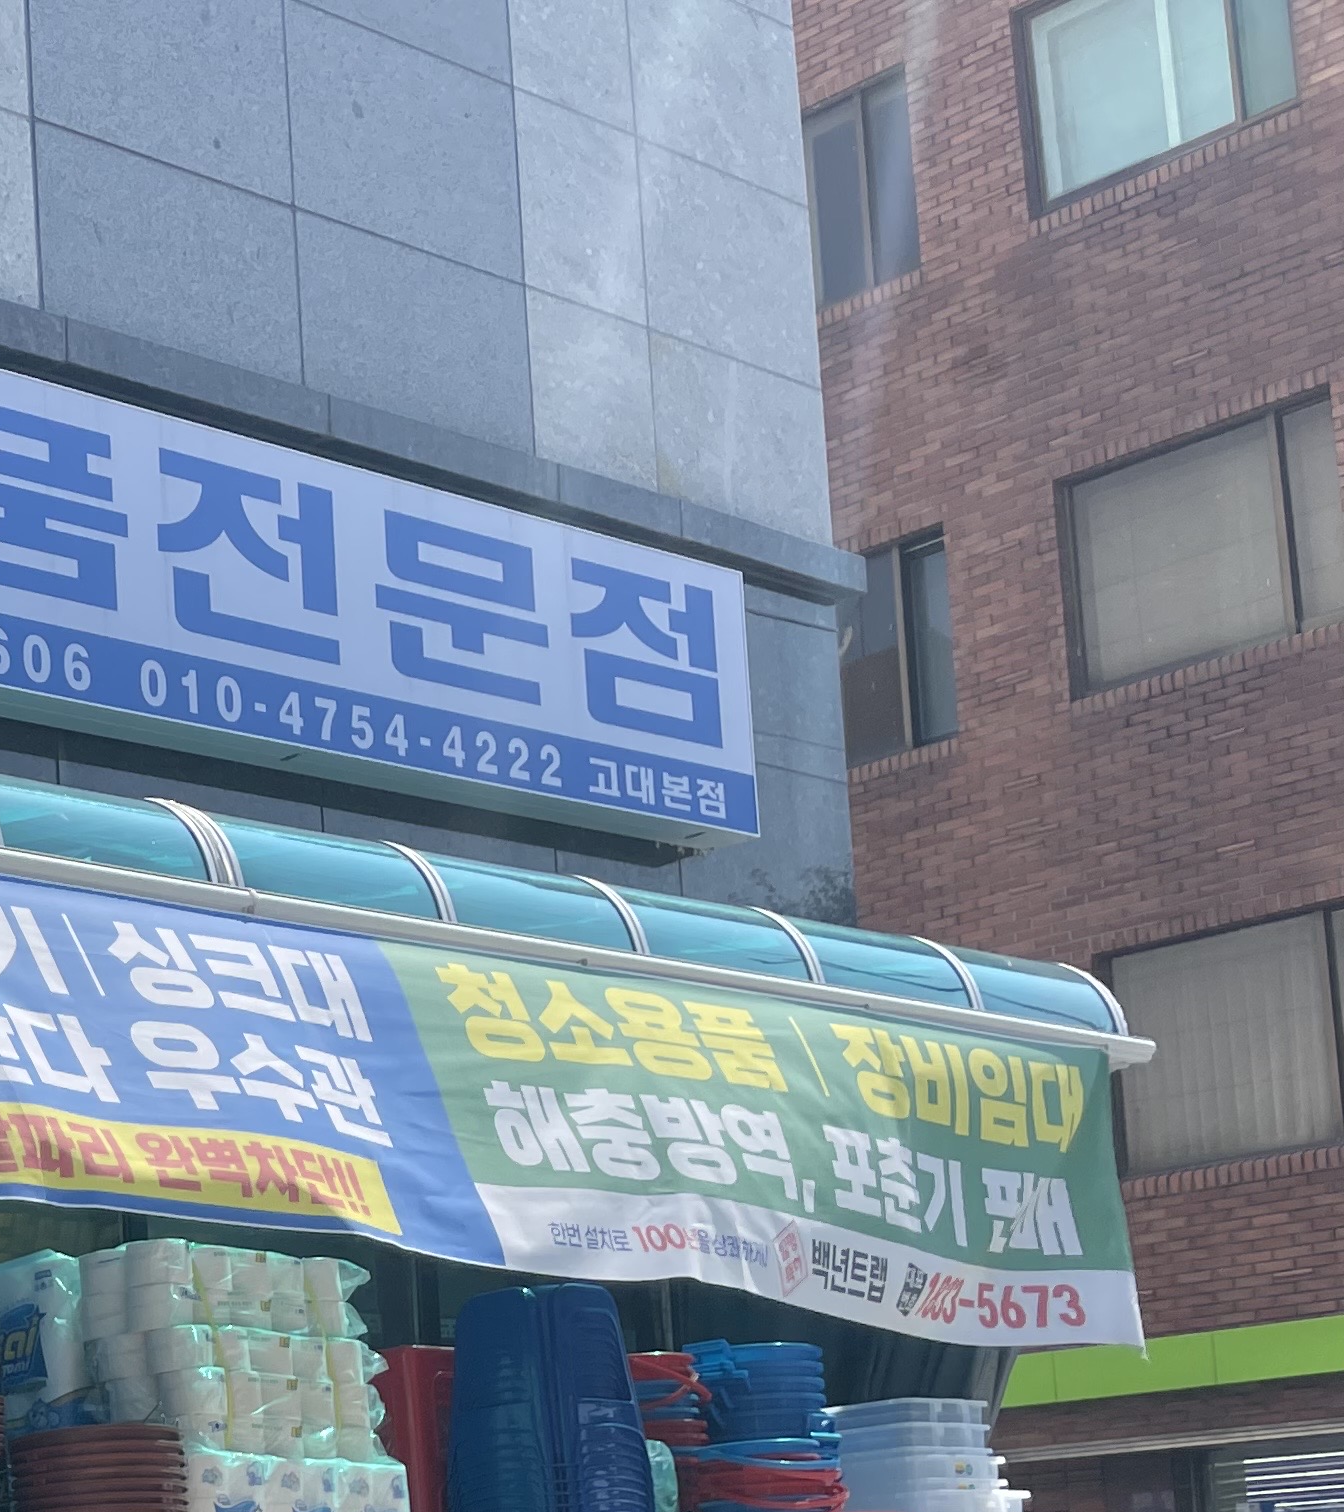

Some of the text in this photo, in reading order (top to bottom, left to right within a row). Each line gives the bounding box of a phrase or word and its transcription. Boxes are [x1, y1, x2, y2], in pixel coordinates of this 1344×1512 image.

[140, 657, 563, 787] 010-4754-4222
[588, 756, 728, 819] 고대본점
[107, 923, 373, 1042] 싱크대
[435, 962, 788, 1093] 청소용품
[129, 1019, 393, 1148] 우수관
[829, 1022, 1084, 1152] 장비임대
[133, 1132, 370, 1216] 완벽차단!!
[484, 1080, 814, 1213] 해충방역,
[822, 1124, 968, 1247] 포춘기
[584, 1230, 633, 1252] 설치로
